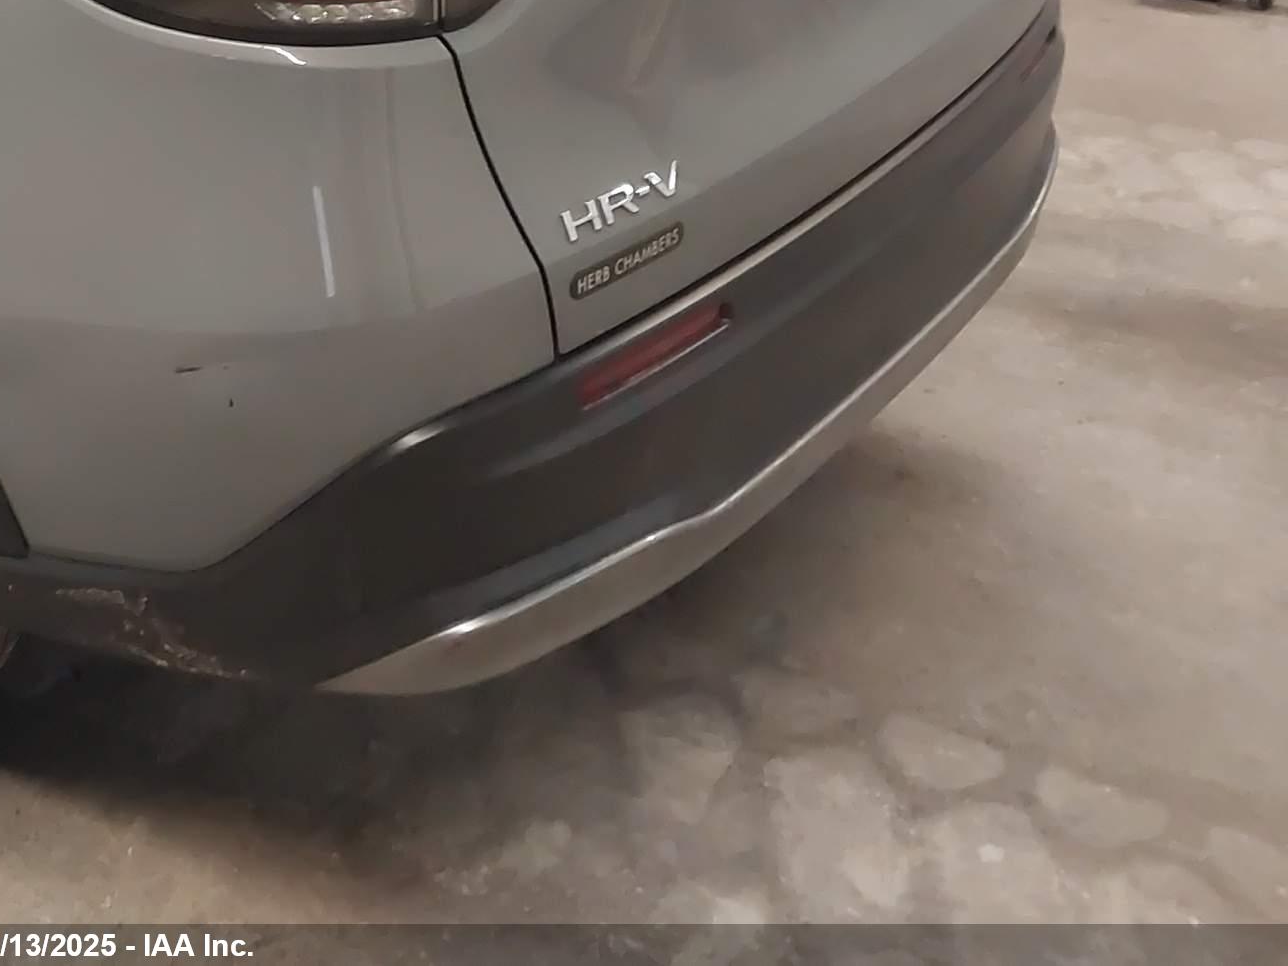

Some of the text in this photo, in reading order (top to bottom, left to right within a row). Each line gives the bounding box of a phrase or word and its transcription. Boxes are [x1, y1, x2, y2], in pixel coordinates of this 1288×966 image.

[560, 159, 677, 242] HR-V
[577, 228, 679, 294] HERB CHAMBERS
